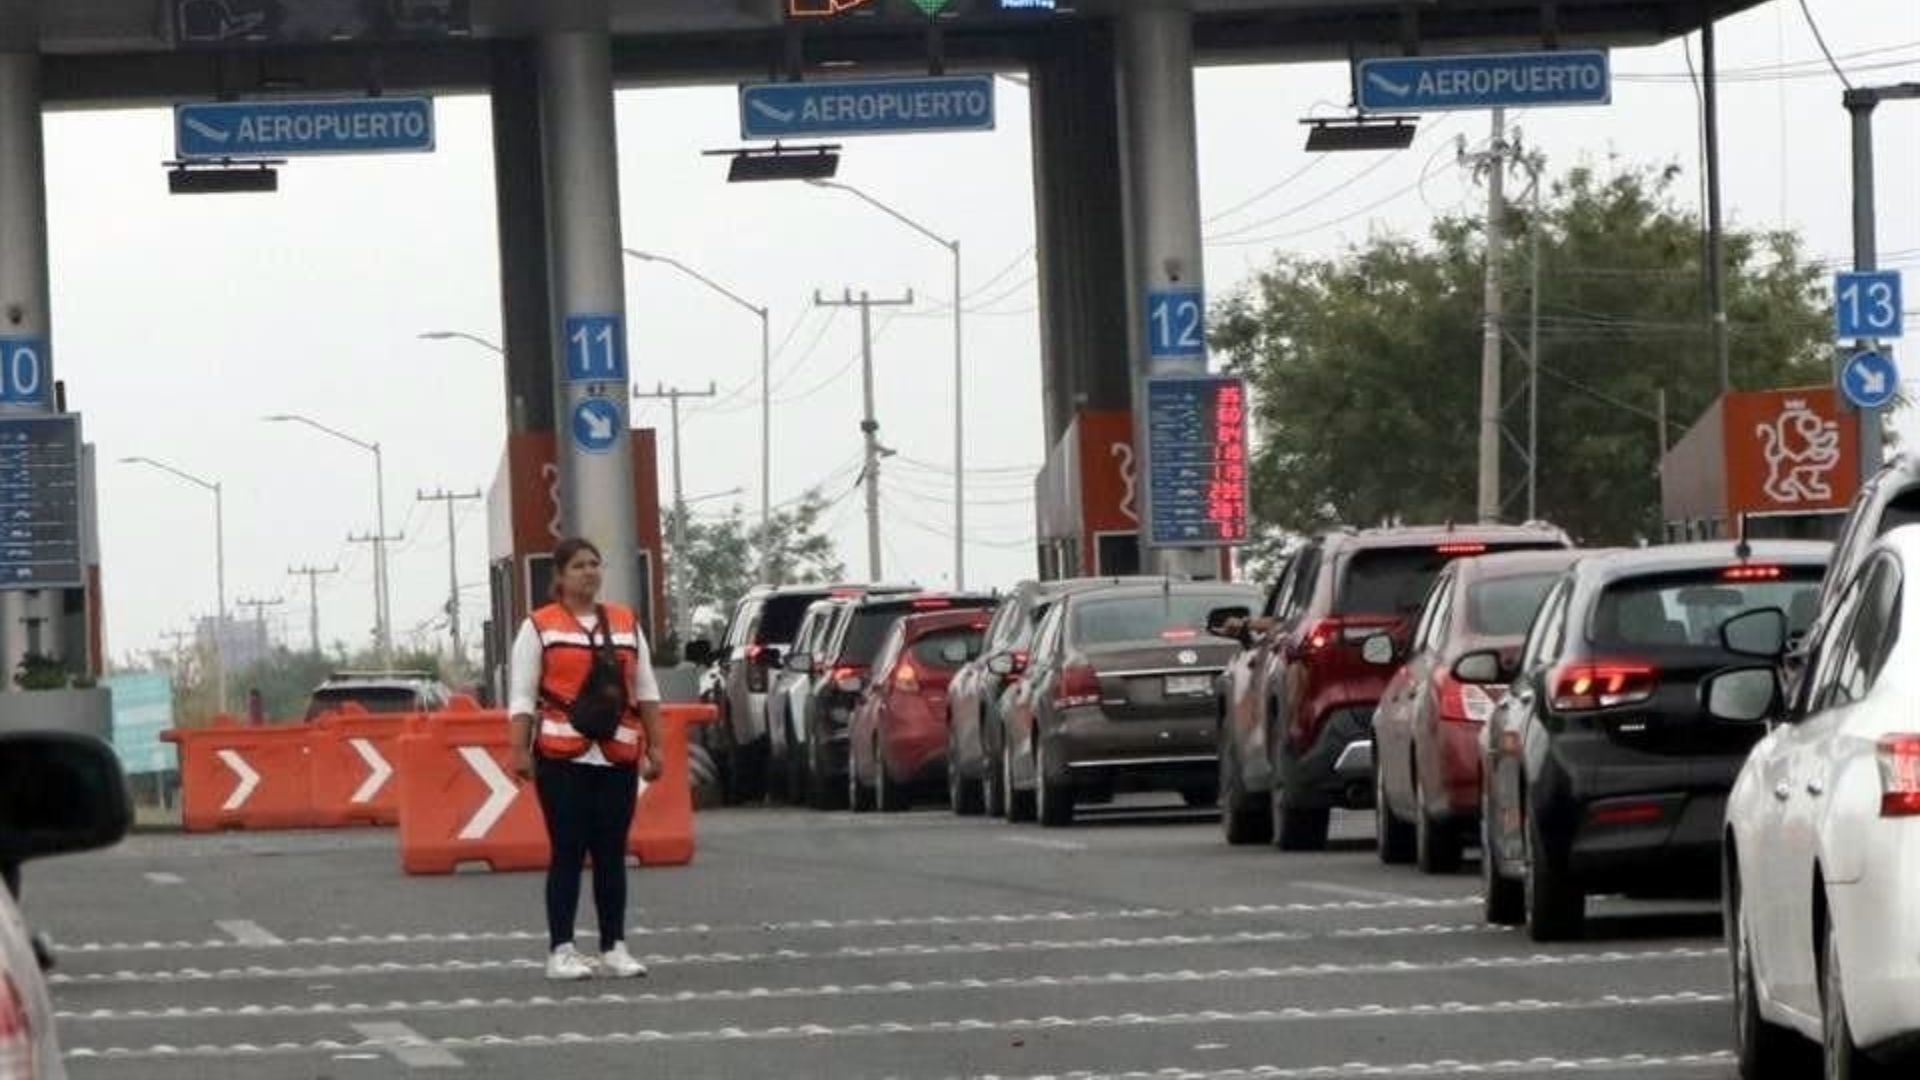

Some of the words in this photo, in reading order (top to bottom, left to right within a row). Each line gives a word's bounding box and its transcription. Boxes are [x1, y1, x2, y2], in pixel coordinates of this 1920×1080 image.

[1416, 63, 1600, 96] AEROPUERTO
[237, 111, 424, 143] AEROPUERTO
[802, 90, 986, 122] AEROPUERTO
[1151, 301, 1200, 348] 12
[1841, 281, 1894, 329] 13
[572, 324, 614, 371] 11
[0, 348, 39, 395] 0
